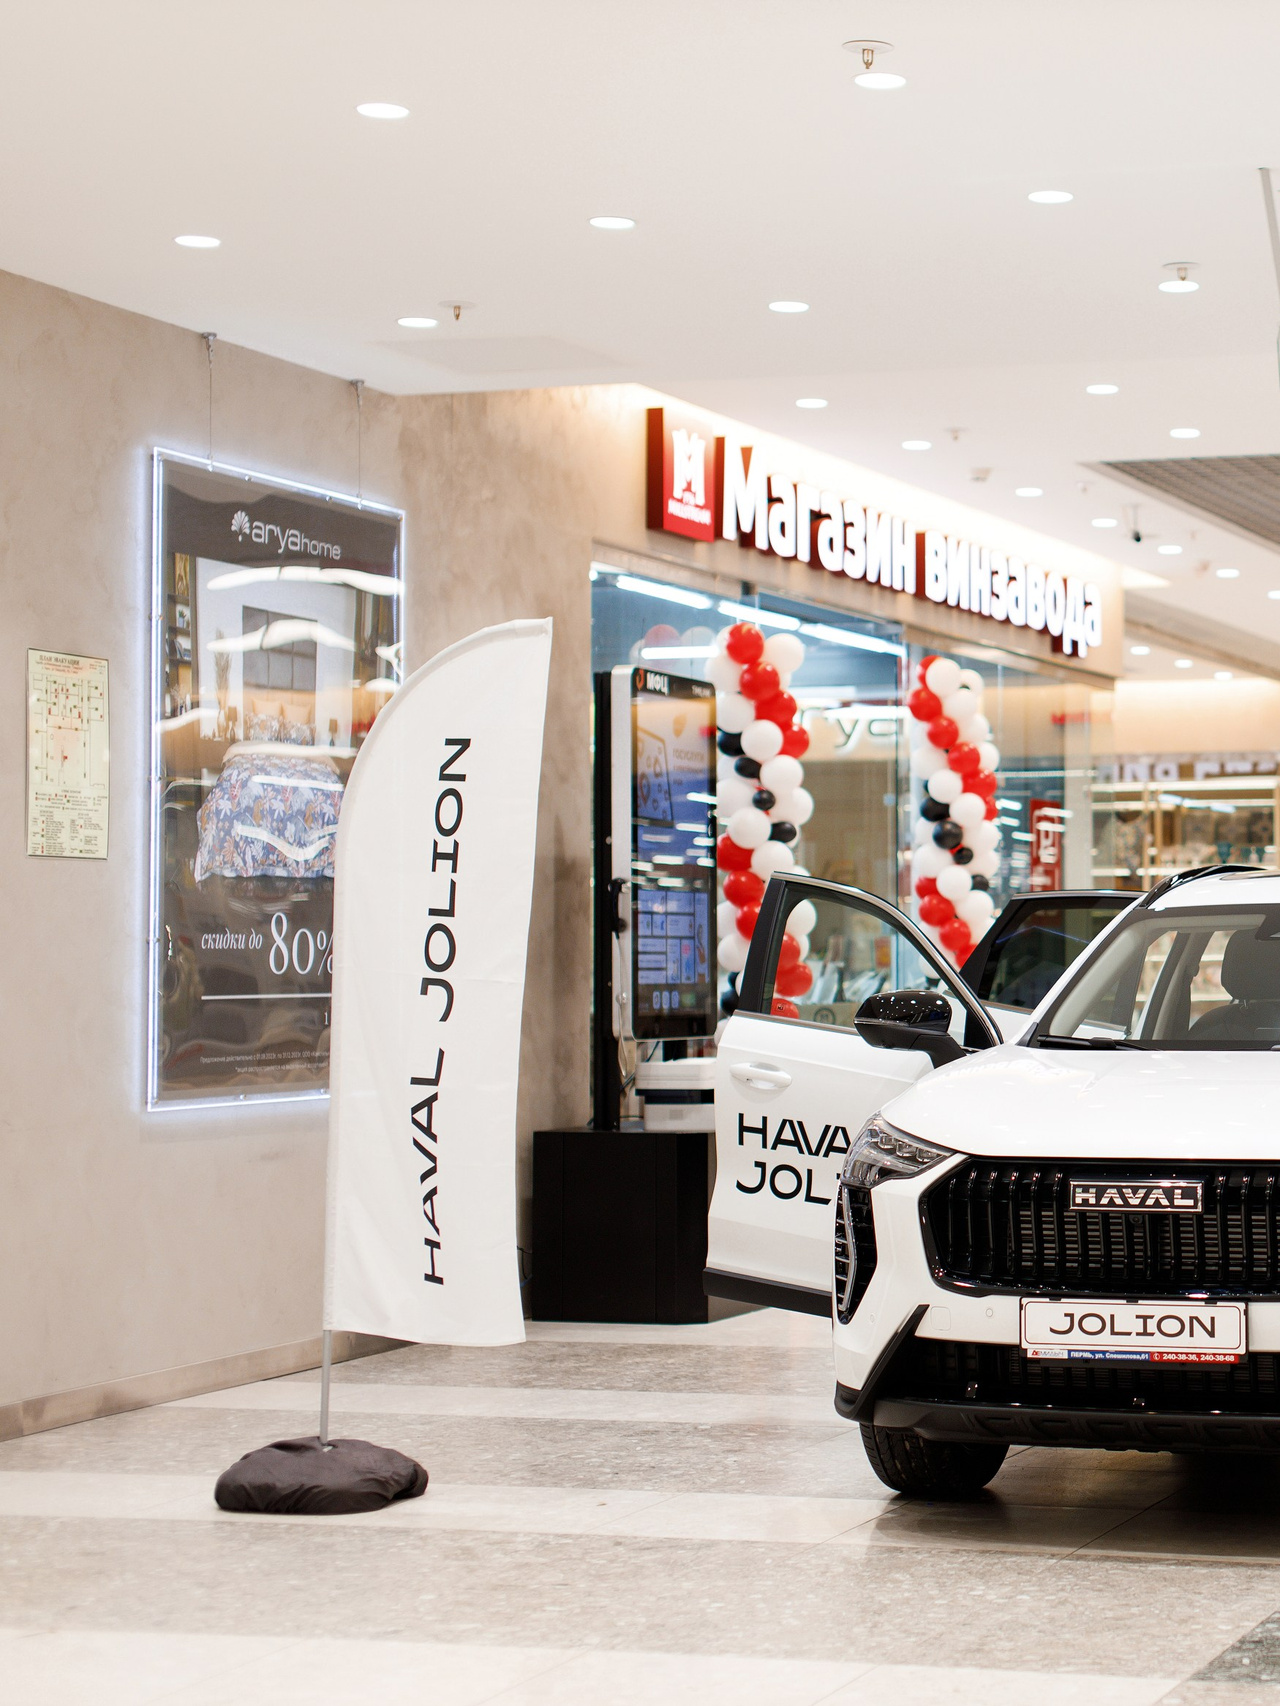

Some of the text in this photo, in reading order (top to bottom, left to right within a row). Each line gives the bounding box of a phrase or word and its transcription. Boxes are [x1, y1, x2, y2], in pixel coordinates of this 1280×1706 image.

[722, 437, 1102, 658] Магазин винзавода
[646, 671, 669, 696] МФЦ
[201, 927, 246, 950] скидки
[248, 927, 263, 950] до
[409, 737, 472, 1286] HAVAL JOLION
[738, 1112, 852, 1158] HAVA
[735, 1160, 841, 1206] JOL
[1074, 1187, 1195, 1206] HAVAL
[1049, 1312, 1216, 1339] JOLION
[1070, 1351, 1095, 1360] ПЕРМЬ,
[1162, 1353, 1199, 1362] 240-38-36,
